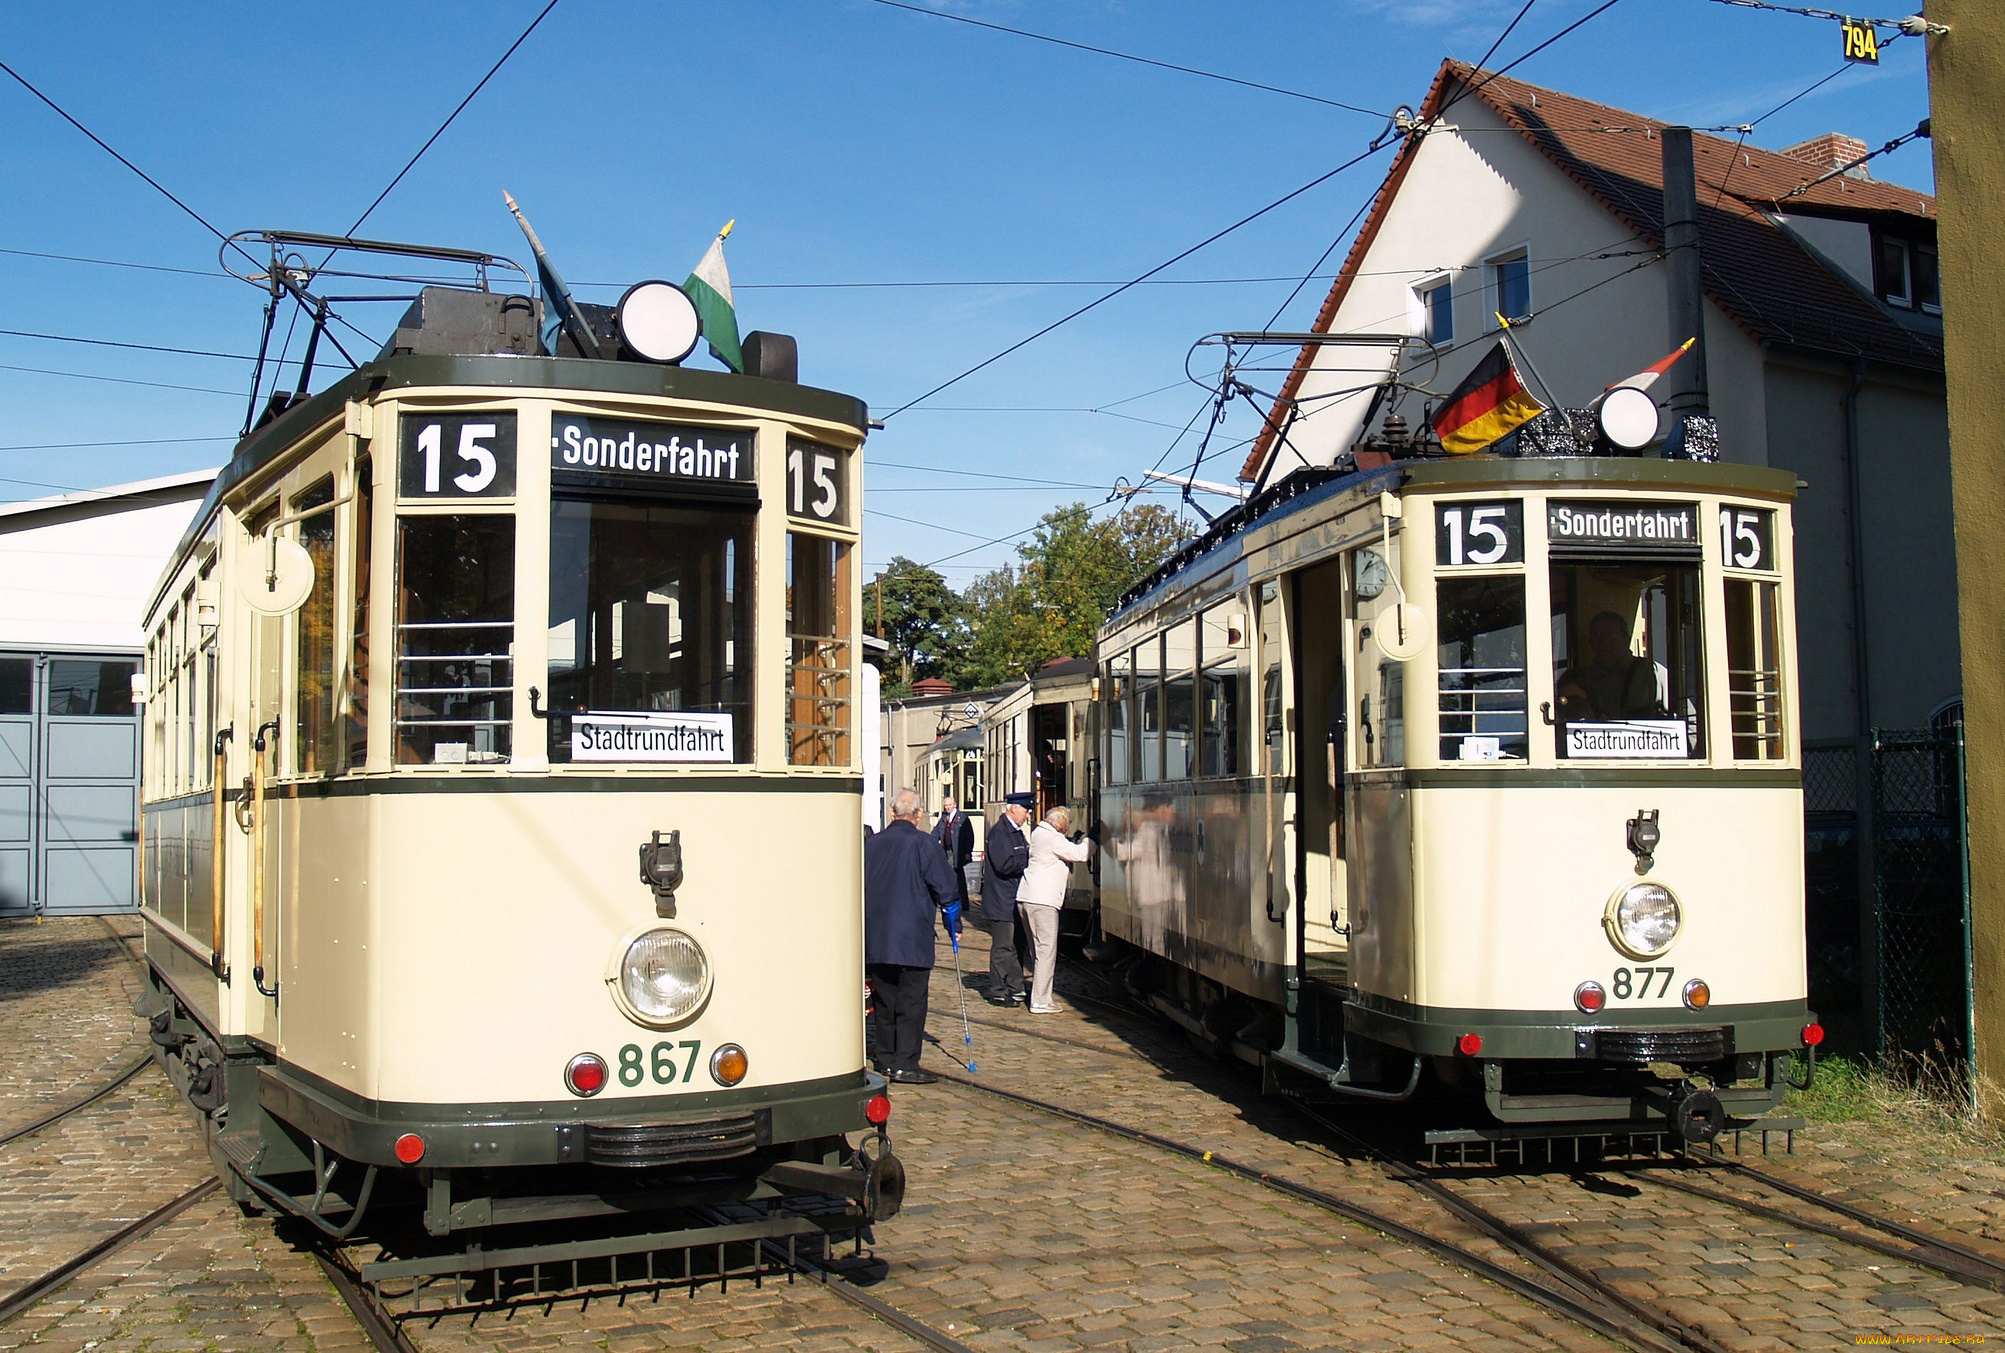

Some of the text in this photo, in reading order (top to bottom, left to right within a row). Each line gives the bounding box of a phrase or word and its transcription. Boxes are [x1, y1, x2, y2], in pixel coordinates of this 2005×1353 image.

[1842, 24, 1876, 60] 794
[417, 424, 497, 493] 15
[788, 449, 837, 518] 15
[1443, 505, 1507, 565] 15
[1720, 508, 1761, 568] 15
[581, 723, 725, 752] Stadtrundfahrt
[1573, 729, 1681, 751] Stadtrundfahrt
[1613, 967, 1675, 999] 877
[618, 1040, 701, 1088] 867
